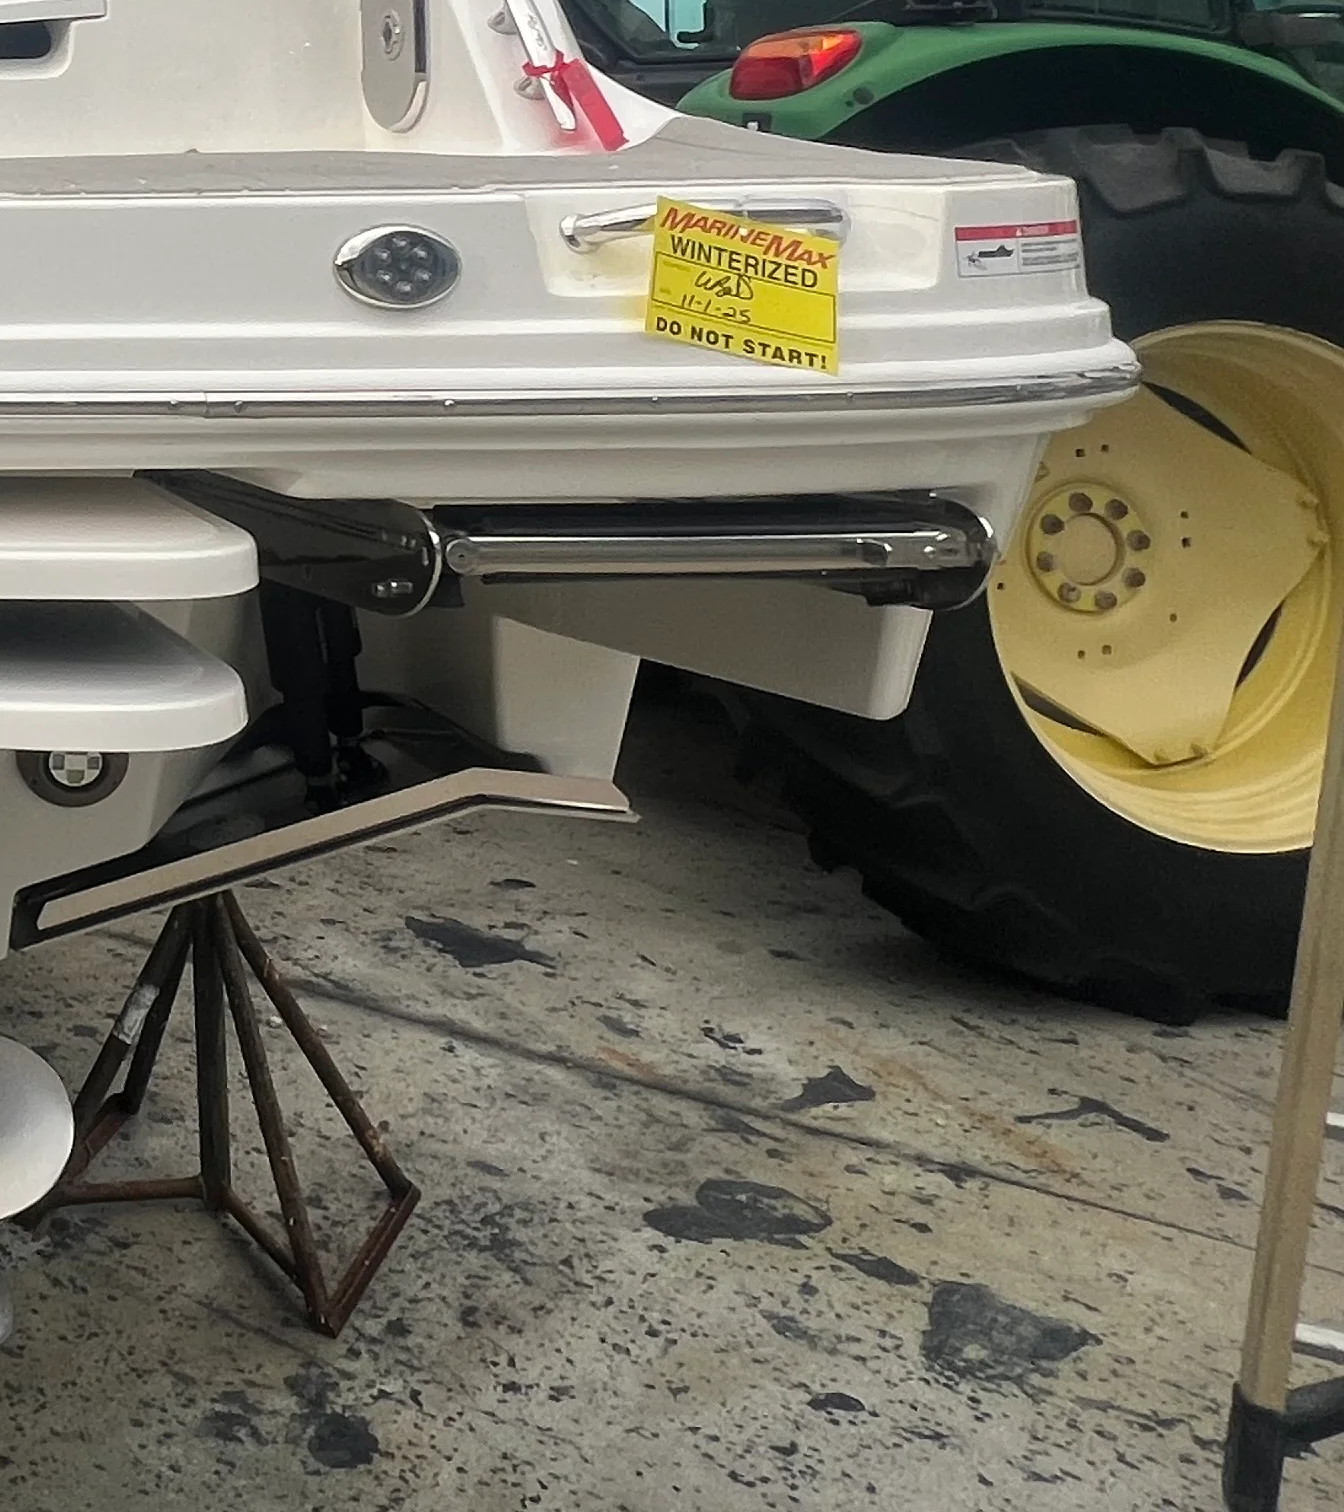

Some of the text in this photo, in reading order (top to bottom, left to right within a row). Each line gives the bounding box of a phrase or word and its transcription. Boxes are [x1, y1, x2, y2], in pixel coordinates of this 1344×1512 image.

[670, 234, 818, 288] WINTERIZED
[681, 293, 752, 325] 11-1-25
[656, 316, 827, 370] DO NOT START!
